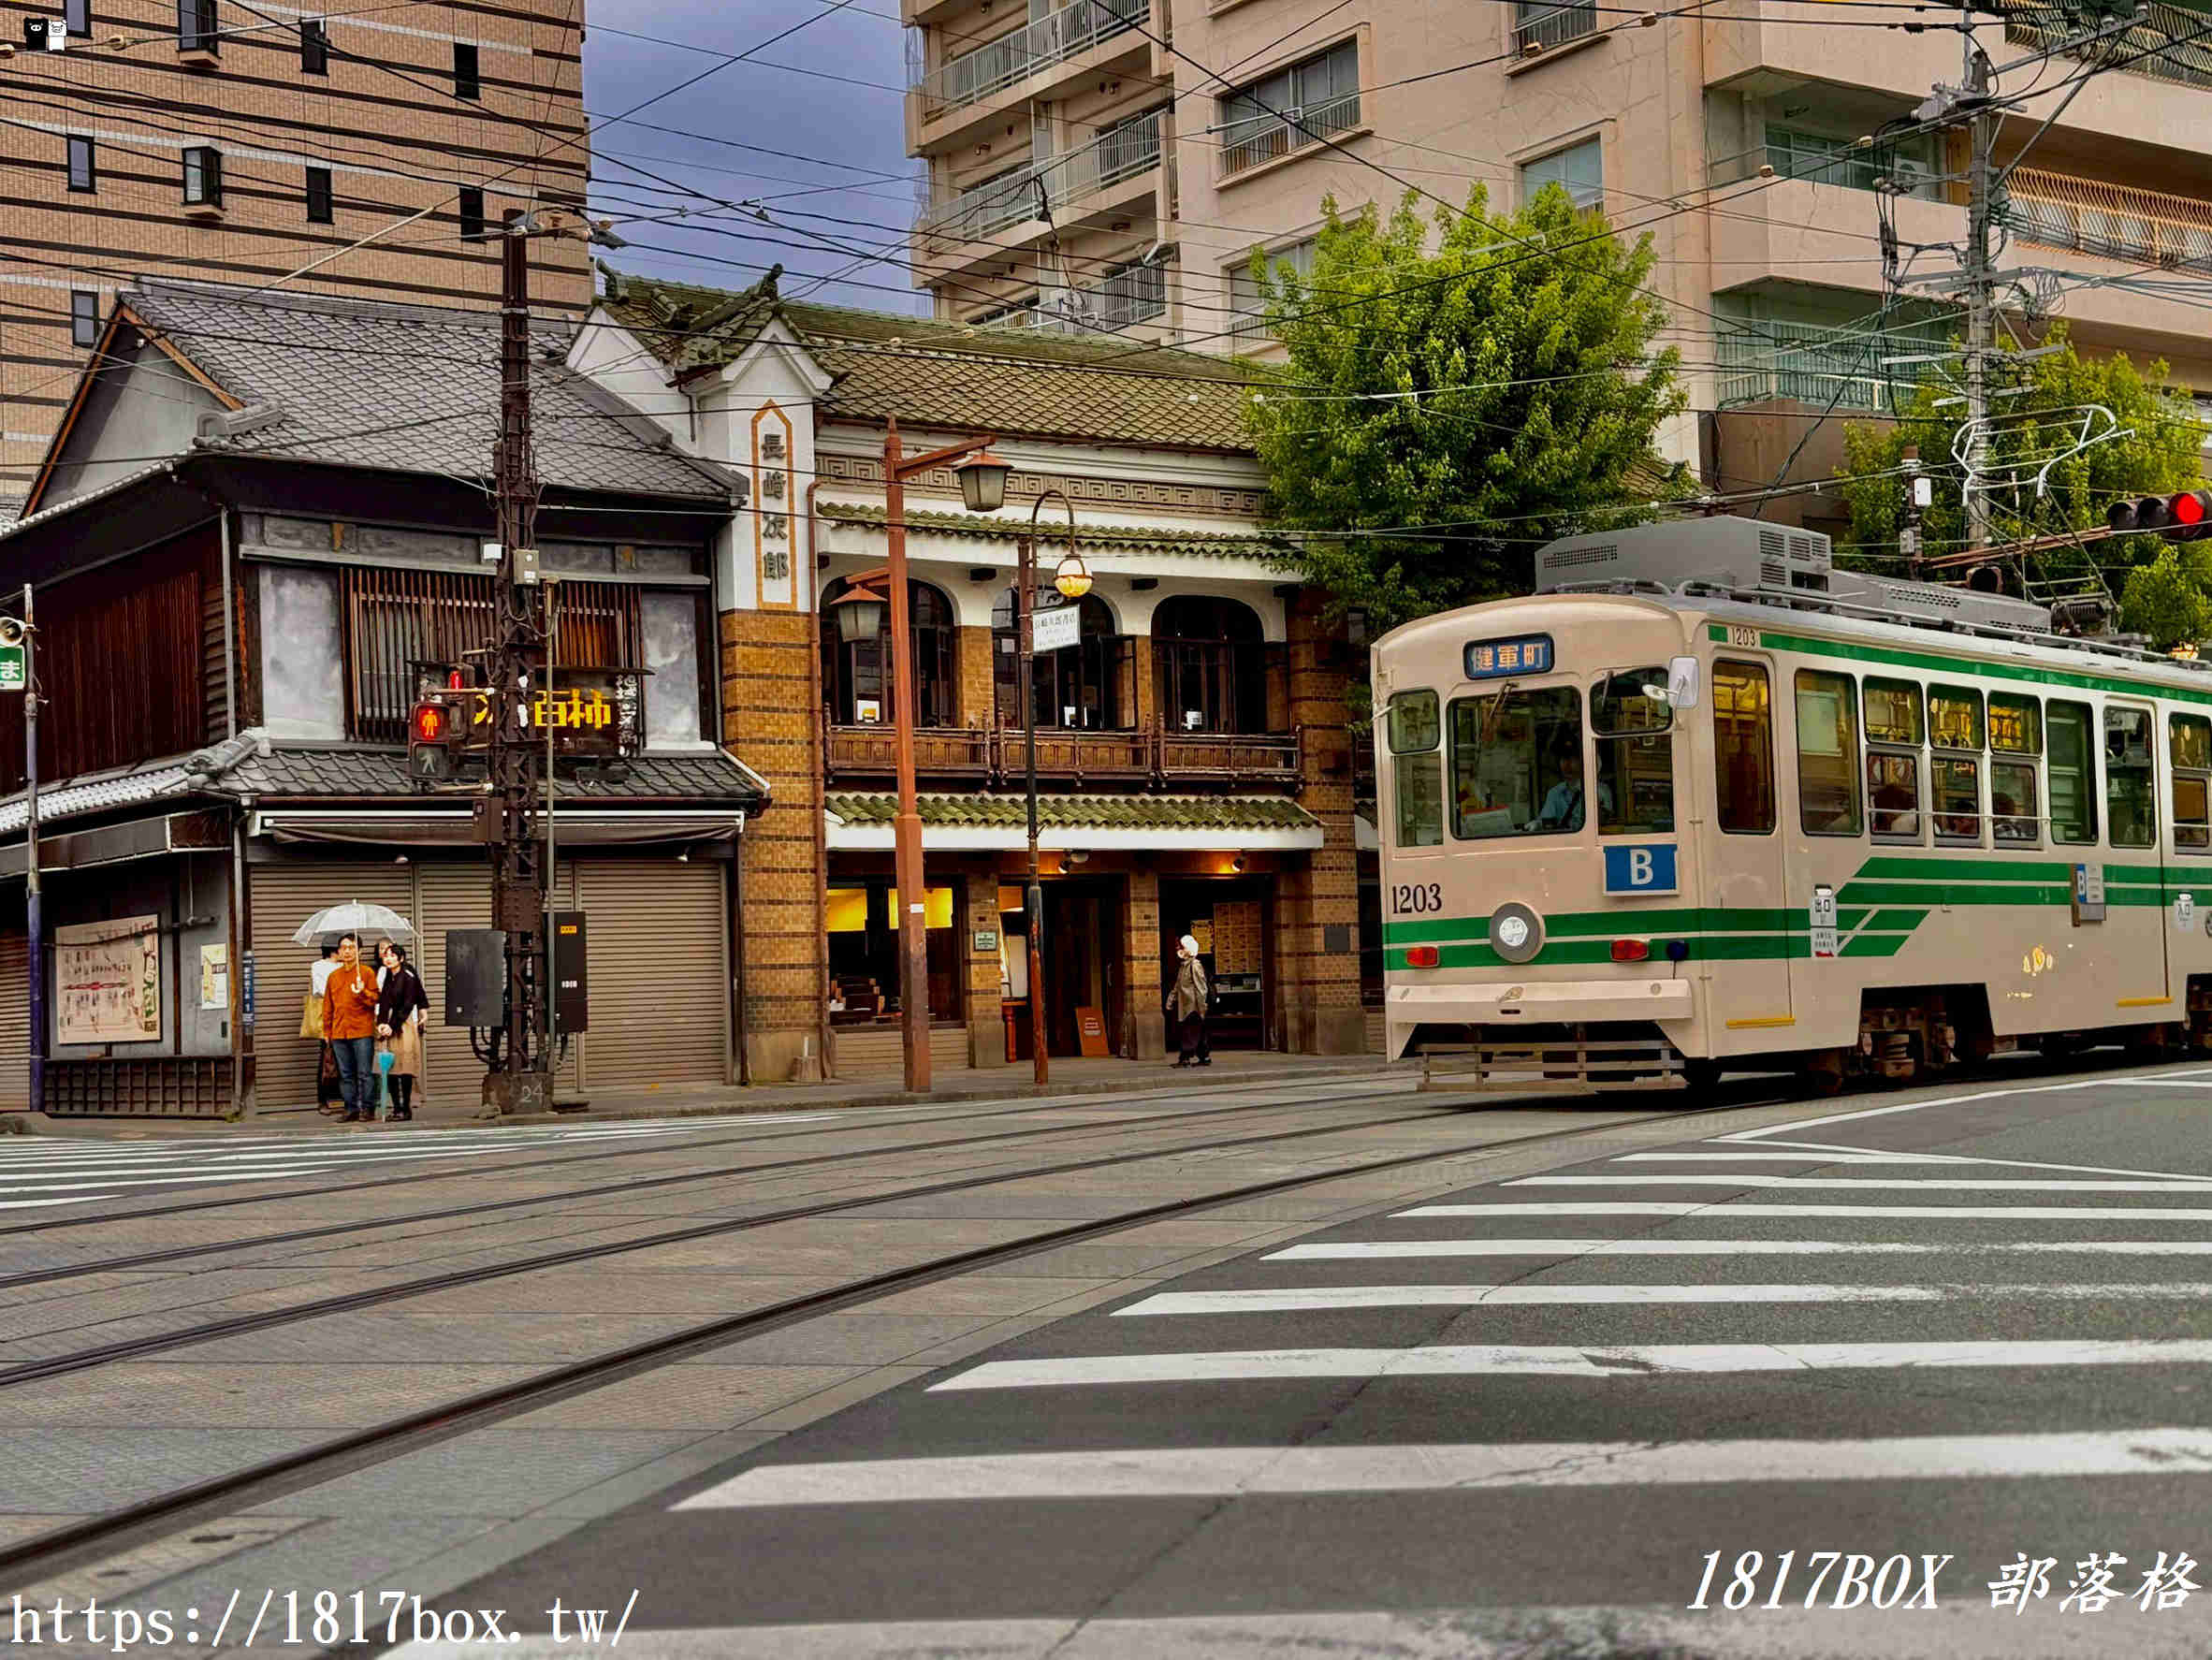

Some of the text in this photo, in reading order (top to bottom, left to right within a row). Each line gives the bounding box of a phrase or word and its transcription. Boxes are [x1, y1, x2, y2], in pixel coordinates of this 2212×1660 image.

[1731, 627, 1756, 647] 1203
[1471, 643, 1545, 671] 健軍町
[1630, 849, 1654, 885] B
[1391, 882, 1443, 914] 1203
